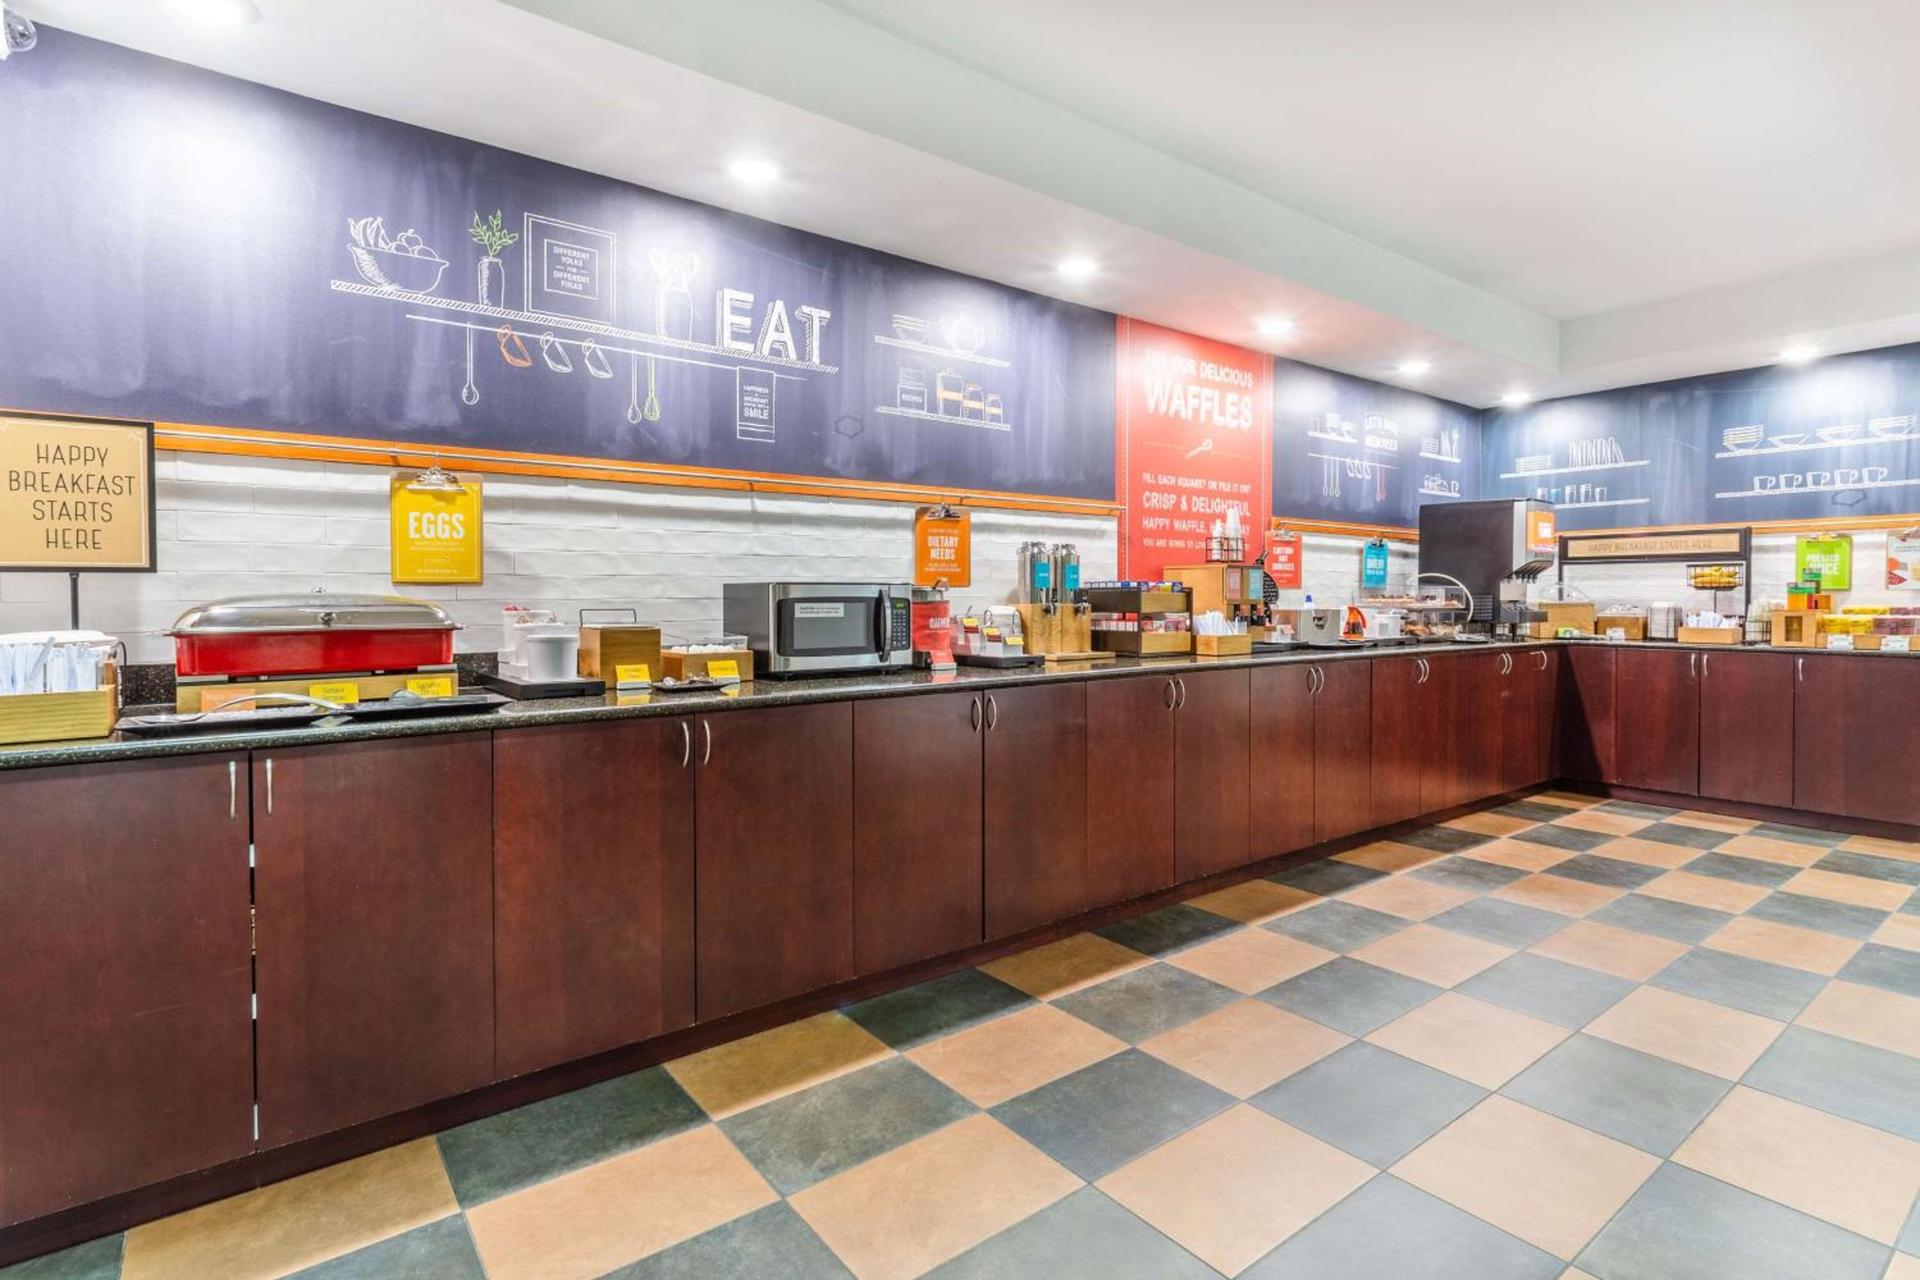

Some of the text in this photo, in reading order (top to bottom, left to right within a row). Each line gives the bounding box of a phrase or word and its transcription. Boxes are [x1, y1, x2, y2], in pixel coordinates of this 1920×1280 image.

[716, 288, 831, 365] EAT
[1199, 361, 1254, 389] DELICIOUS
[743, 406, 769, 420] SMILE
[1144, 375, 1253, 431] WAFFLES
[36, 443, 109, 467] HAPPY
[9, 470, 136, 496] BREAKFAST
[32, 499, 113, 523] STARTS
[1143, 491, 1177, 510] CRISP
[1181, 494, 1187, 511] &
[409, 511, 465, 539] EGGS
[1142, 517, 1170, 530] HAPPY
[45, 528, 104, 550] HERE
[930, 547, 956, 561] NEEDS
